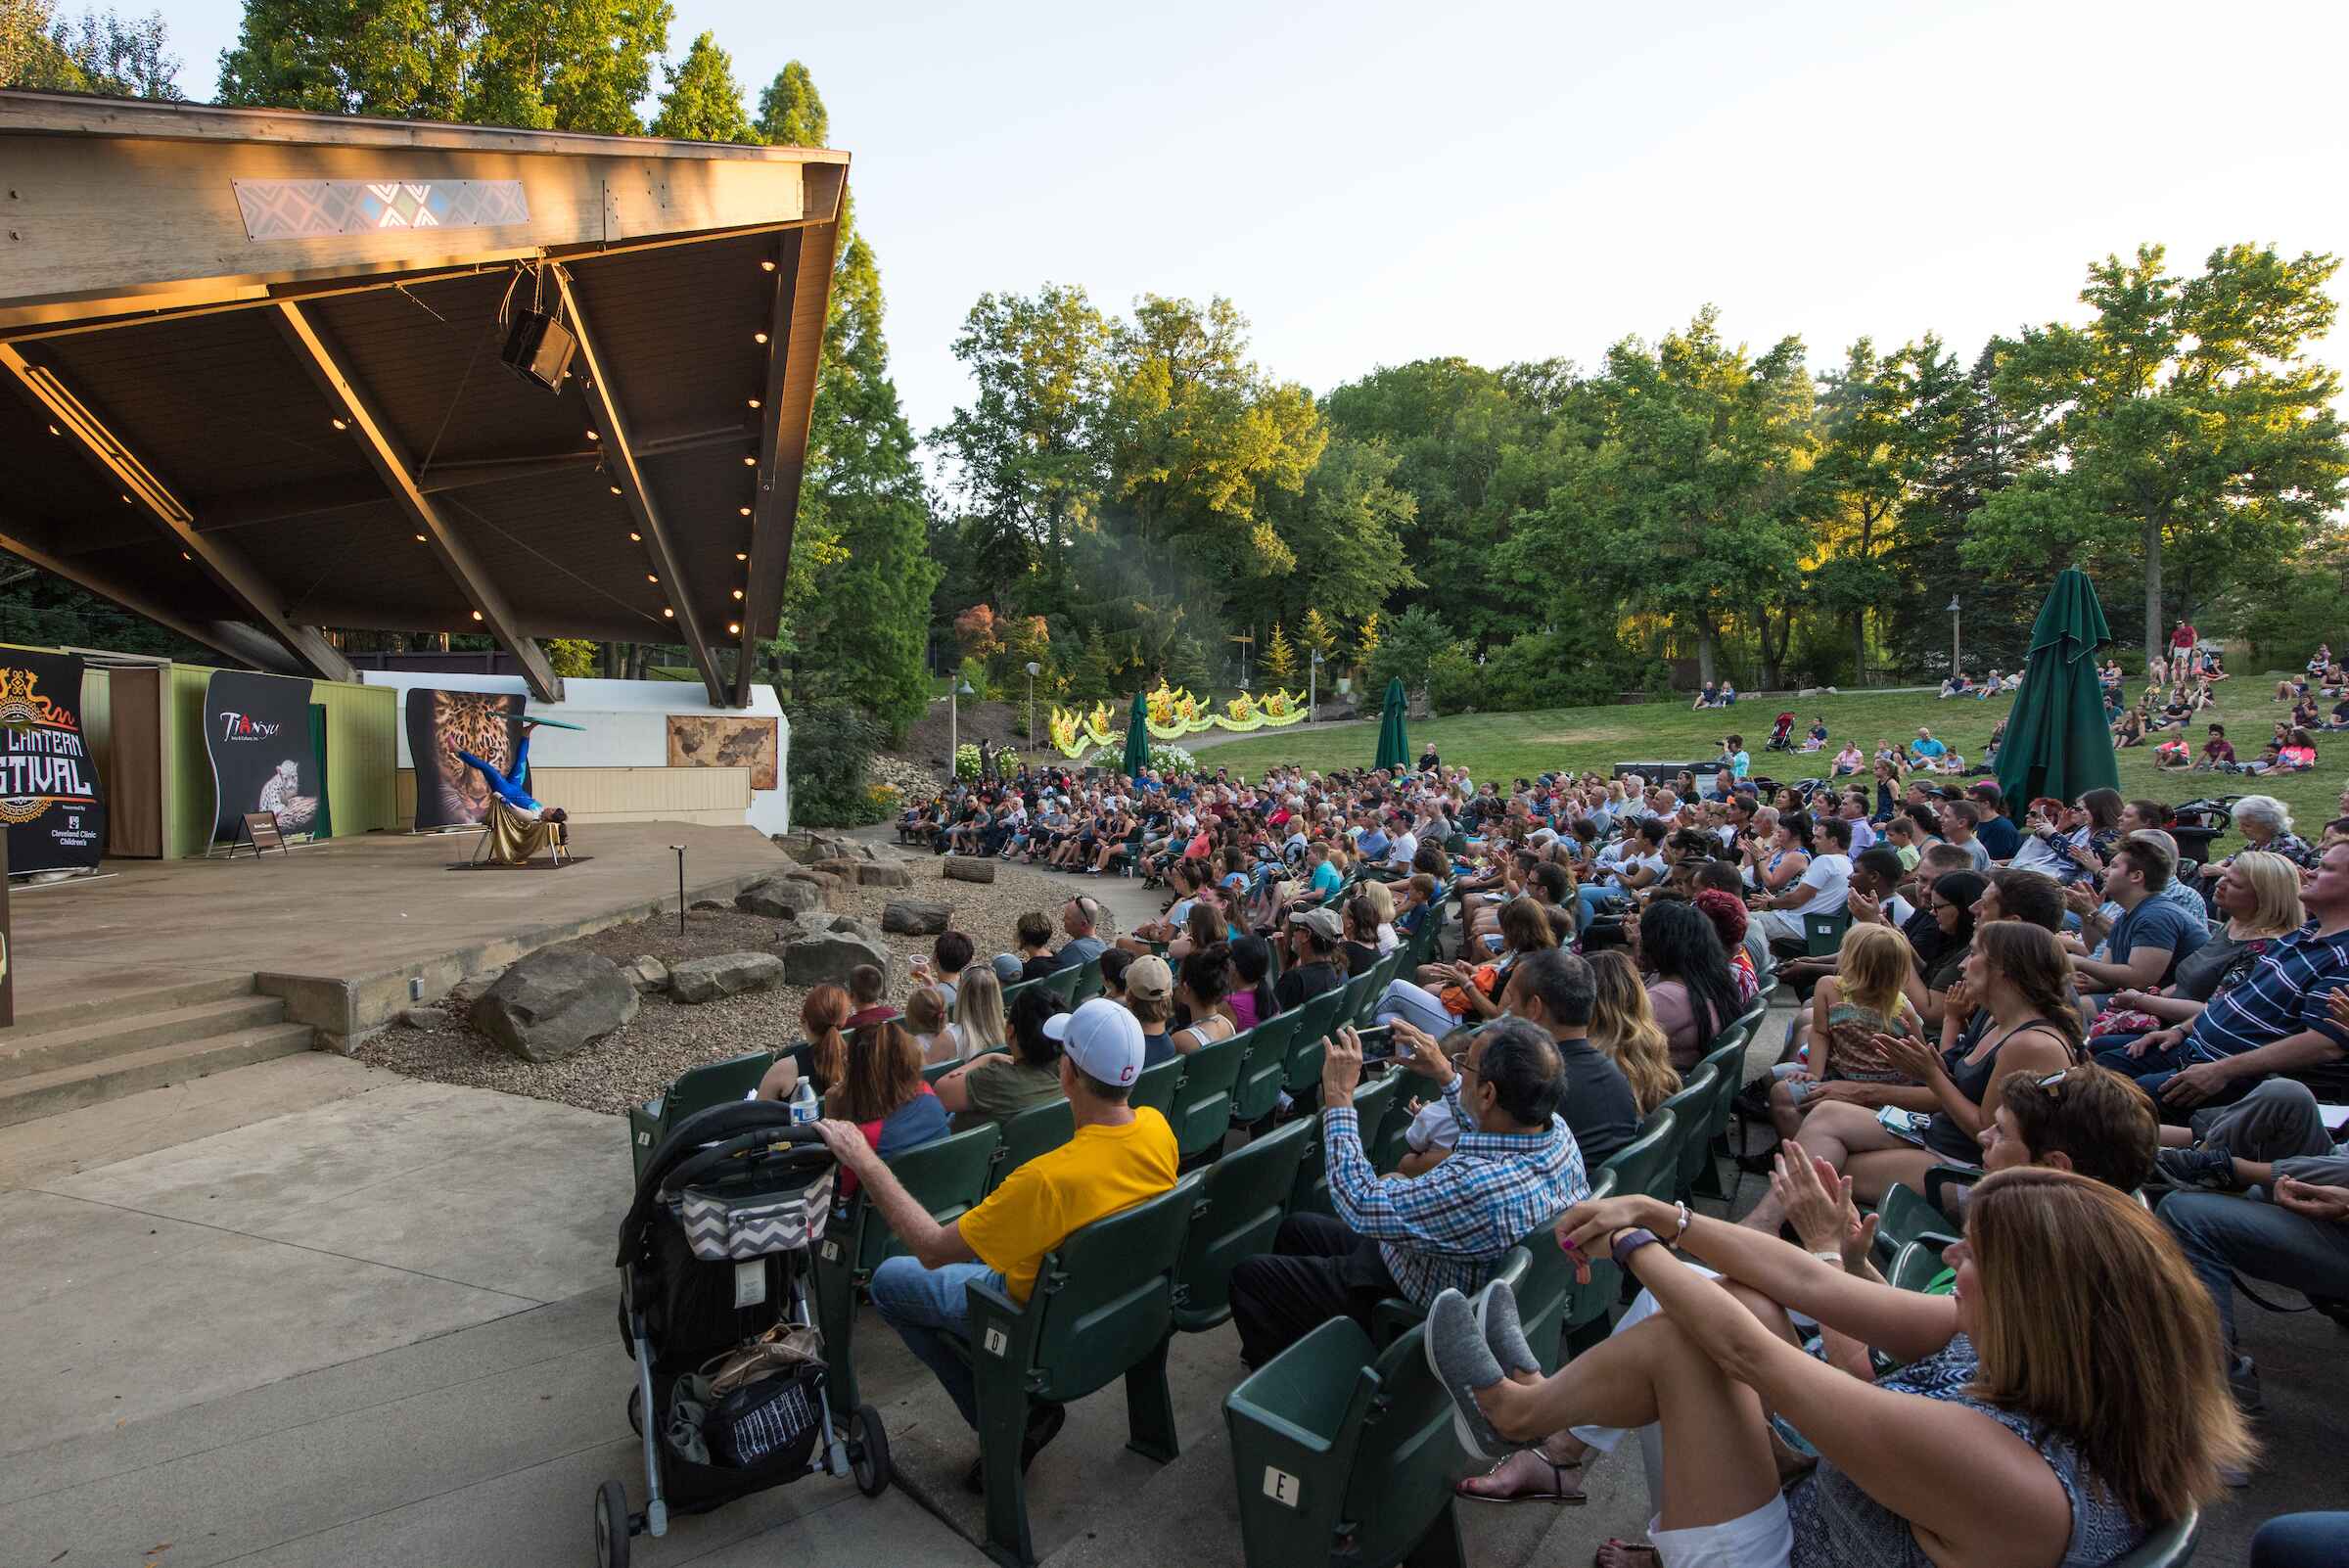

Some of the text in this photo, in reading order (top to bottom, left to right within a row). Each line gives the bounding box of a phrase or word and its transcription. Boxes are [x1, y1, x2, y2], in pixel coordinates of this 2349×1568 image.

[8, 728, 83, 757] LANTERN
[51, 829, 97, 839] Cleveland Clinic
[1121, 1066, 1134, 1082] C
[1276, 1473, 1286, 1499] E
